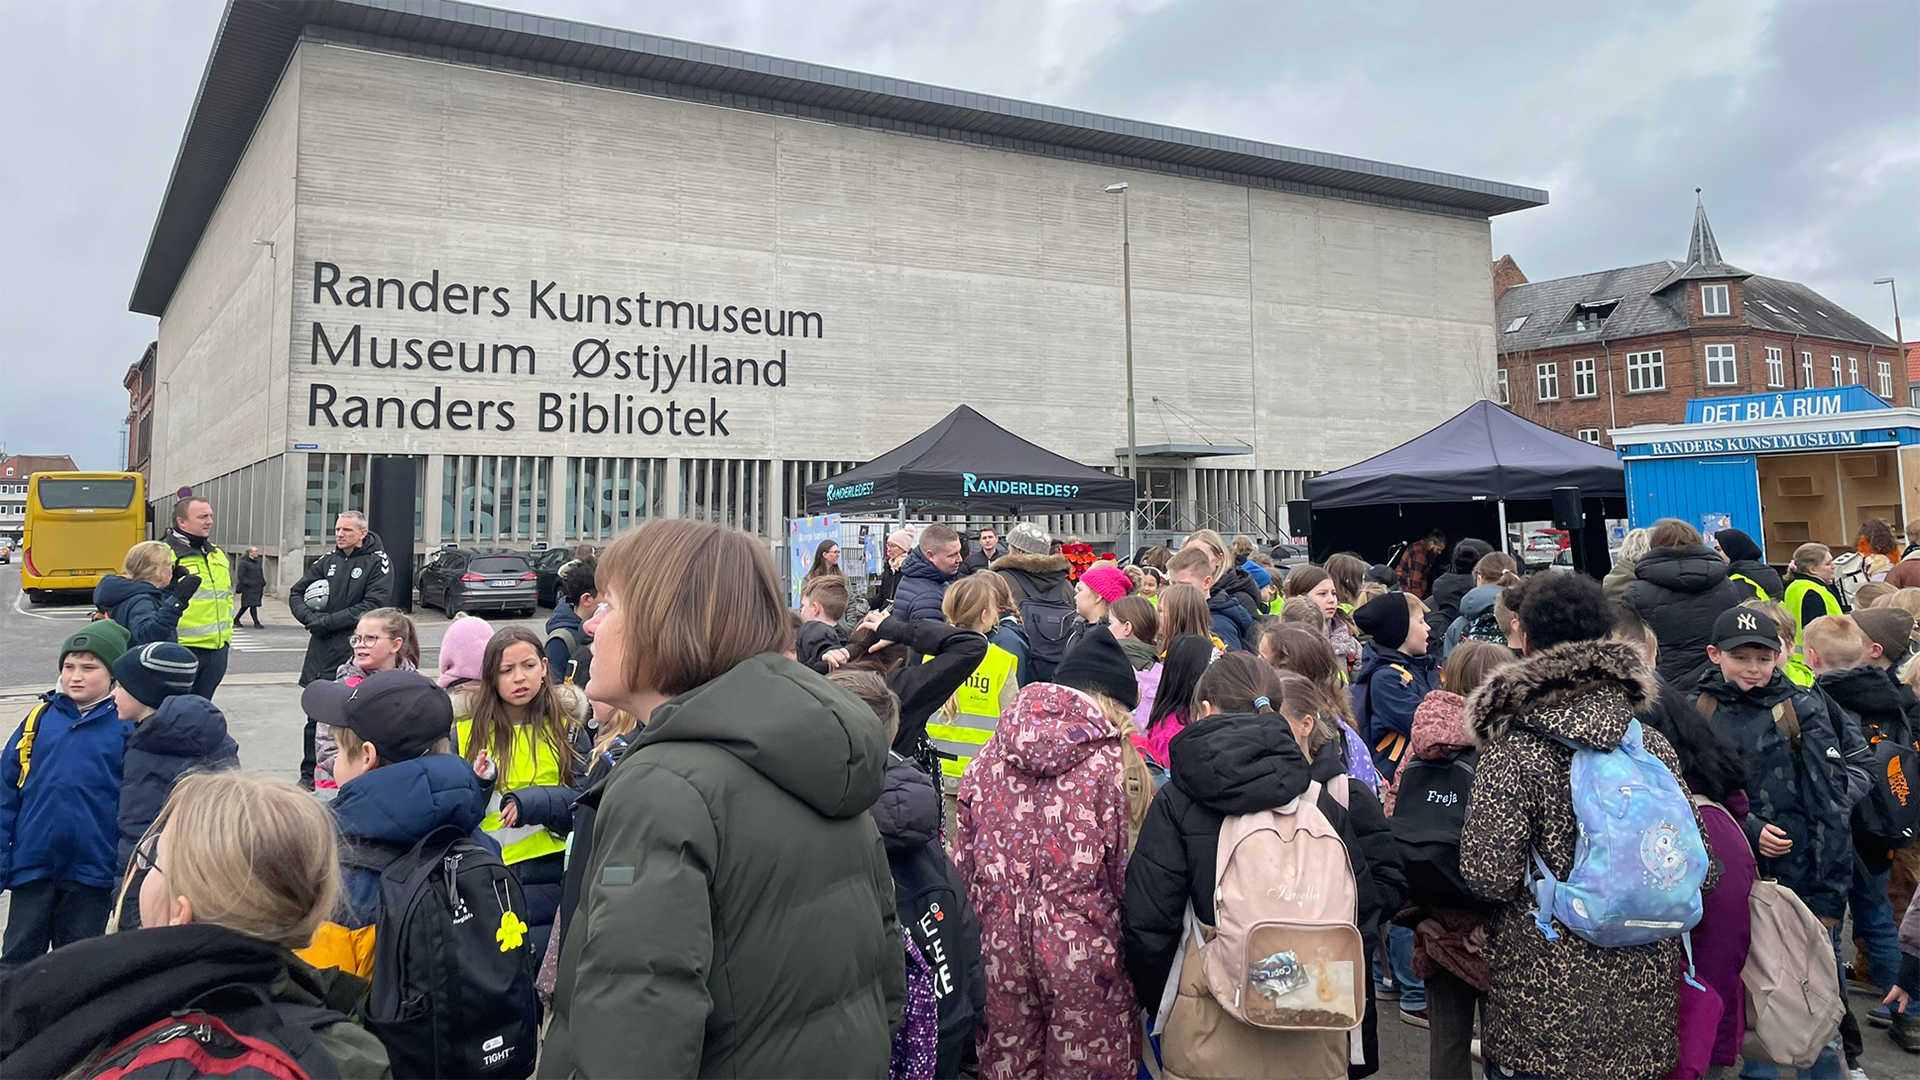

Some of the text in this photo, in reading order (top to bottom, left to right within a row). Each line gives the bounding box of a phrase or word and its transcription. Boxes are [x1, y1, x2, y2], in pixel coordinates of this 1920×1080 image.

[314, 262, 822, 338] Randers Kunstmuseum
[312, 322, 785, 393] Museum Østjylland
[309, 384, 729, 436] Randers Bibliotek
[1702, 394, 1841, 424] DET BLÅ RUM
[1652, 431, 1857, 455] RANDERS KUNSTMUSEUM
[962, 472, 1080, 498] RANDERLEDES?
[1426, 790, 1458, 807] Freja
